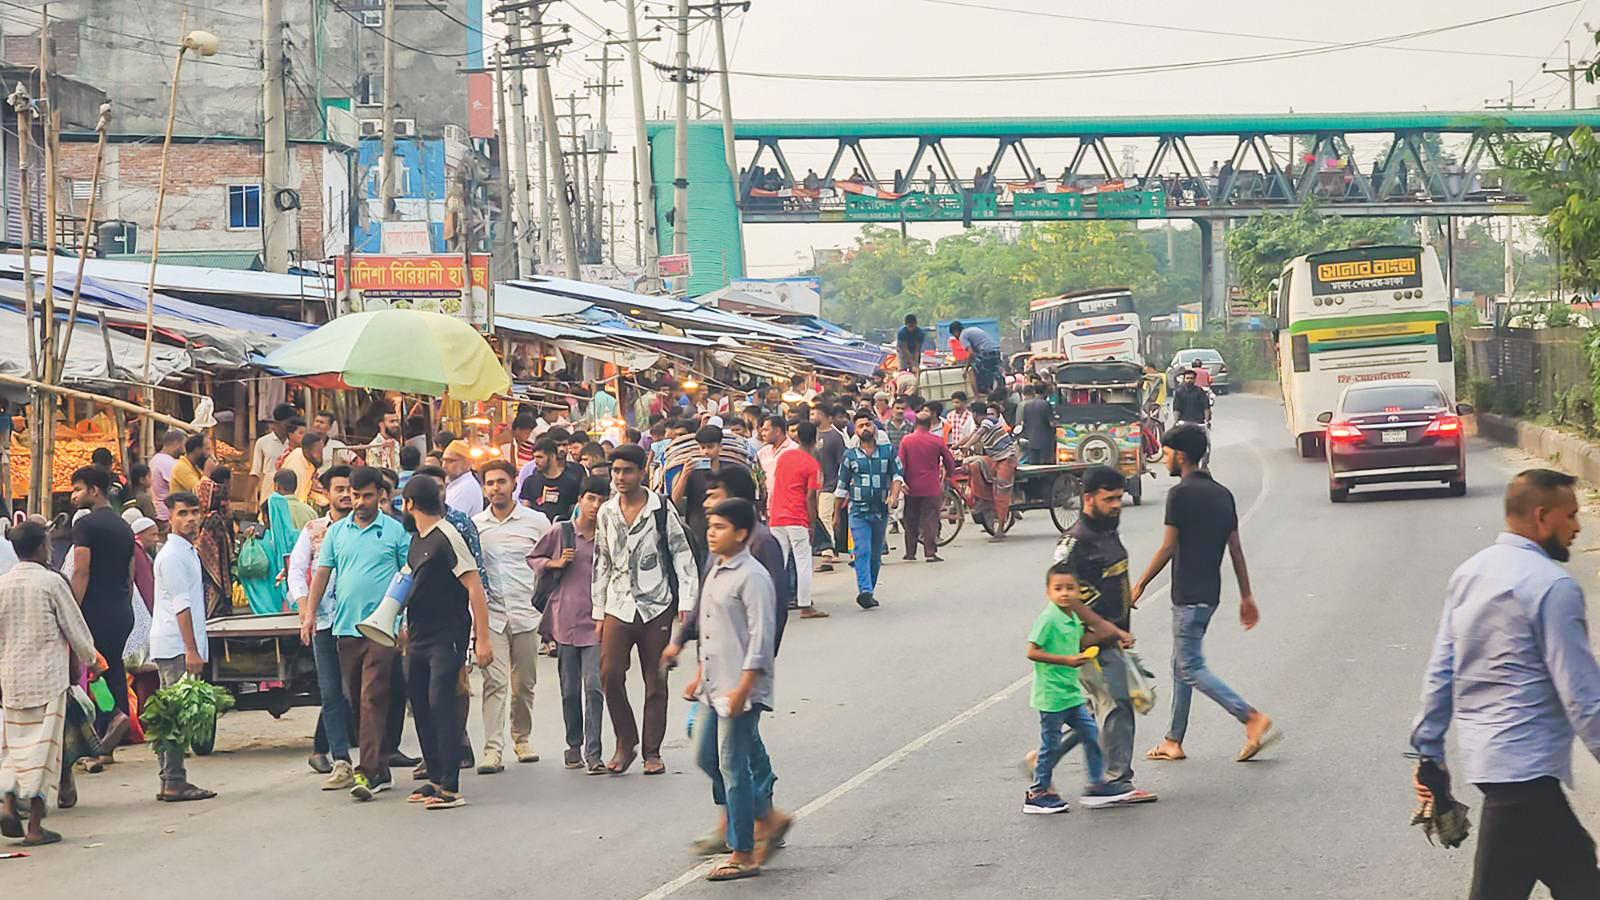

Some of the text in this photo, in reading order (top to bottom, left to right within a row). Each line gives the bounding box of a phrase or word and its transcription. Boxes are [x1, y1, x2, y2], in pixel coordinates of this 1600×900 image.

[390, 260, 444, 285] বিরিয়ানী
[446, 262, 485, 286] হাজ
[1318, 257, 1416, 282] সোনার বাংলা
